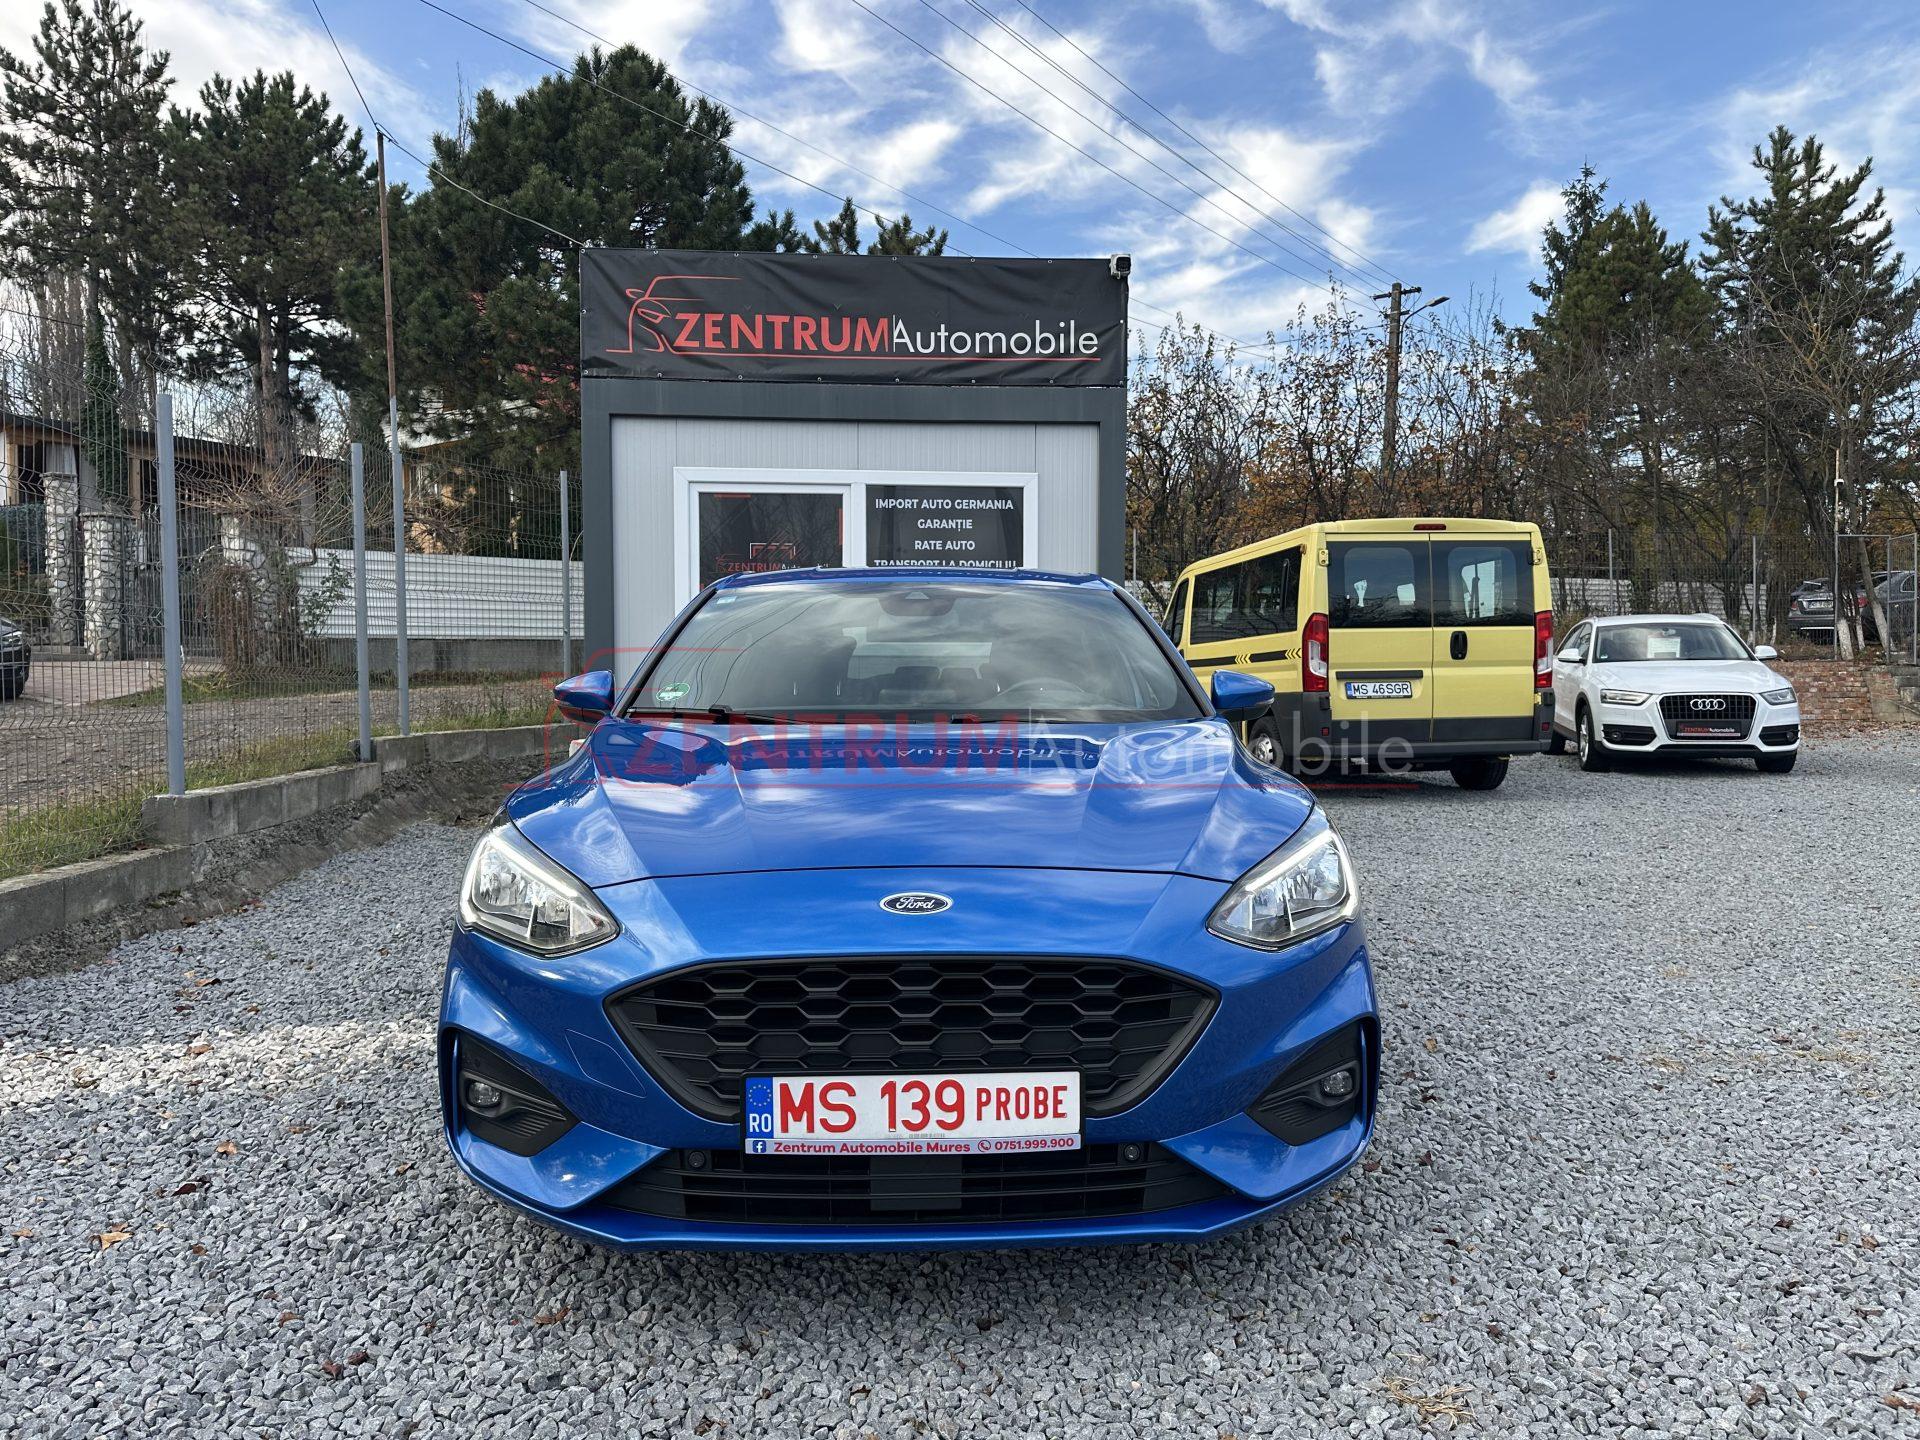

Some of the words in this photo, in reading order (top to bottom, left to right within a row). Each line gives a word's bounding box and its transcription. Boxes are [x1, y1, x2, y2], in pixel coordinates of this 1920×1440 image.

[673, 312, 889, 352] ZENTRUM
[893, 318, 1099, 355] Automobile
[875, 498, 919, 509] IMPORT
[921, 498, 952, 510] AUTO
[954, 499, 1014, 510] GERMANIA
[917, 518, 973, 532] GARANȚIE
[914, 540, 942, 550] RATE
[945, 540, 976, 551] AUTO
[1352, 684, 1369, 694] MS
[895, 896, 936, 909] Ford
[749, 1113, 772, 1133] RO
[779, 1081, 857, 1134] MS
[880, 1079, 965, 1132] 139
[976, 1085, 1068, 1121] PROBE
[773, 1142, 836, 1153] Zentrum
[839, 1141, 922, 1153] Automobile
[926, 1142, 971, 1153] Mures
[994, 1138, 1074, 1151] 0751.999.900
